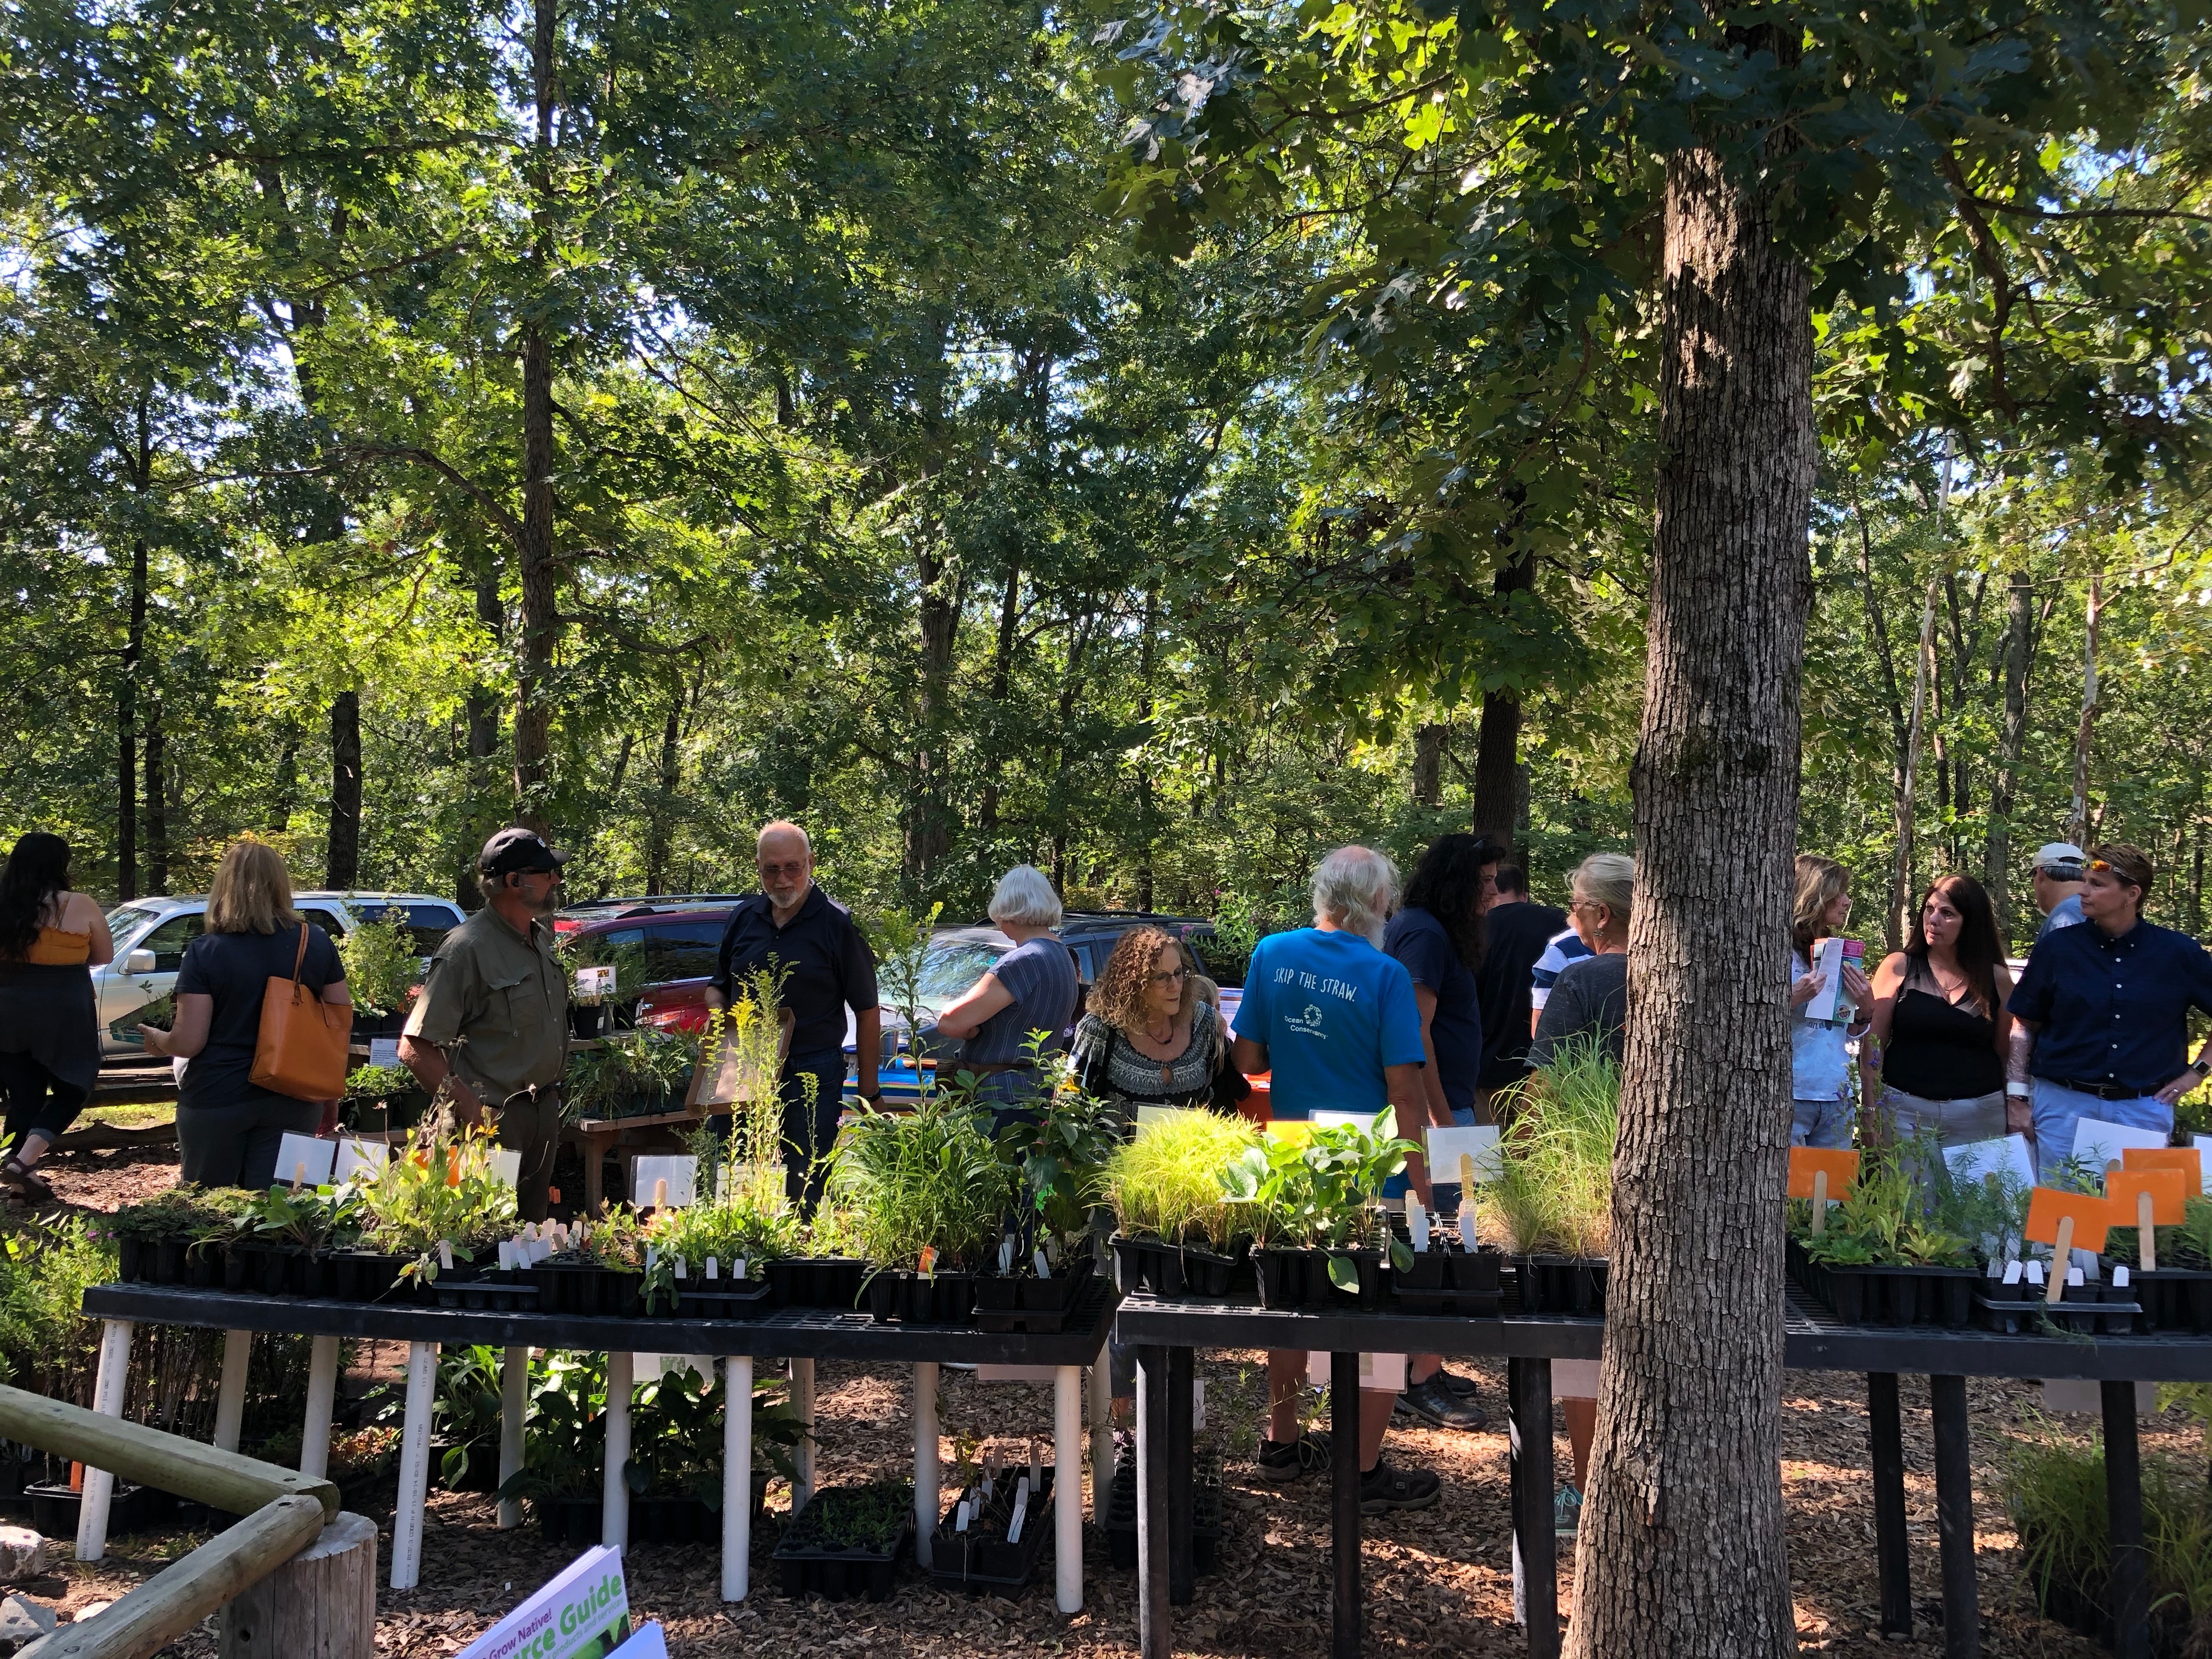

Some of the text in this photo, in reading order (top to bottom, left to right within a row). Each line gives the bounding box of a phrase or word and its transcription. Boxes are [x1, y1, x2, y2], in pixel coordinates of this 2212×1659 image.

[1274, 967, 1357, 1002] SKIP THE STRAW.
[1284, 1015, 1304, 1024] Ocean
[1290, 1025, 1326, 1040] Conservancy
[560, 1573, 622, 1636] Guide
[598, 1597, 623, 1621] services
[489, 1608, 552, 1659] Grow Native!
